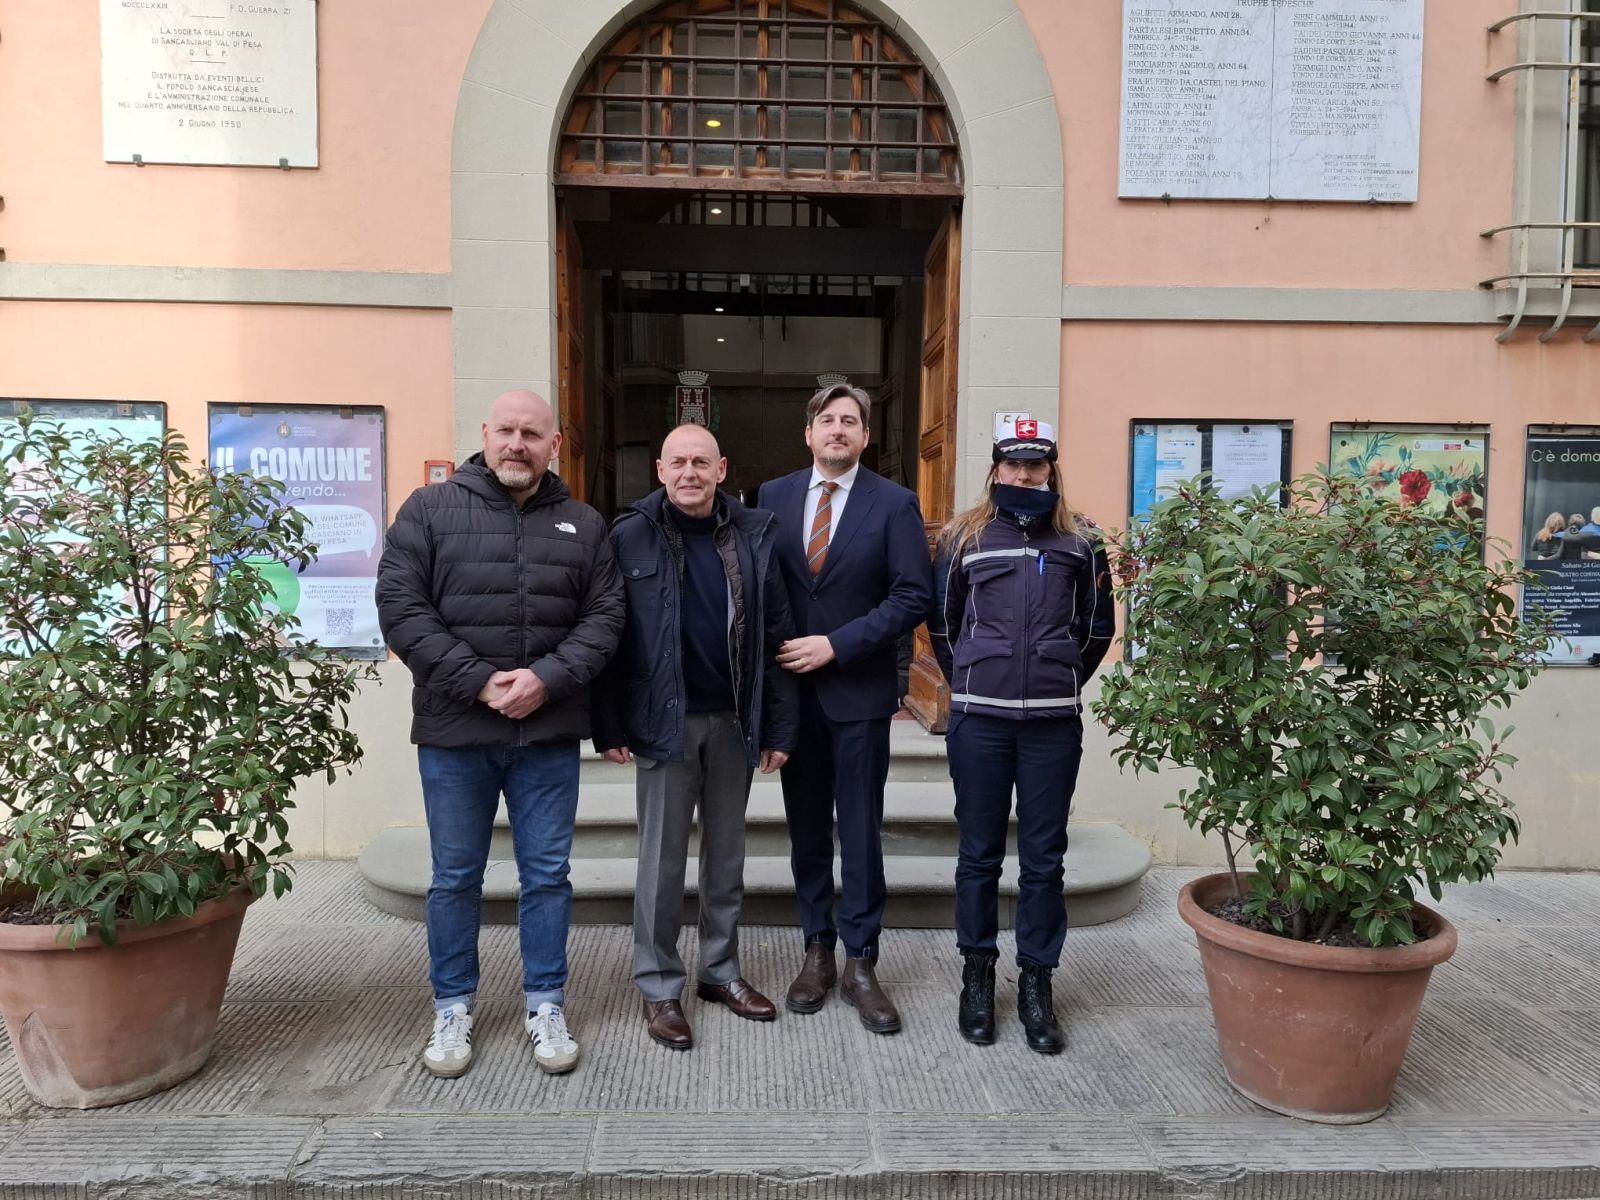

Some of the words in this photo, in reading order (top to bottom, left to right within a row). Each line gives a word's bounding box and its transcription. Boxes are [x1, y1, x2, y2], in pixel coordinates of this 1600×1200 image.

[152, 72, 192, 80] DISTRUTTA
[231, 95, 269, 103] COMUNALE
[189, 120, 215, 128] GIUGNO
[221, 120, 241, 128] 1950
[1531, 449, 1556, 462] C'è
[250, 447, 372, 482] COMUNE
